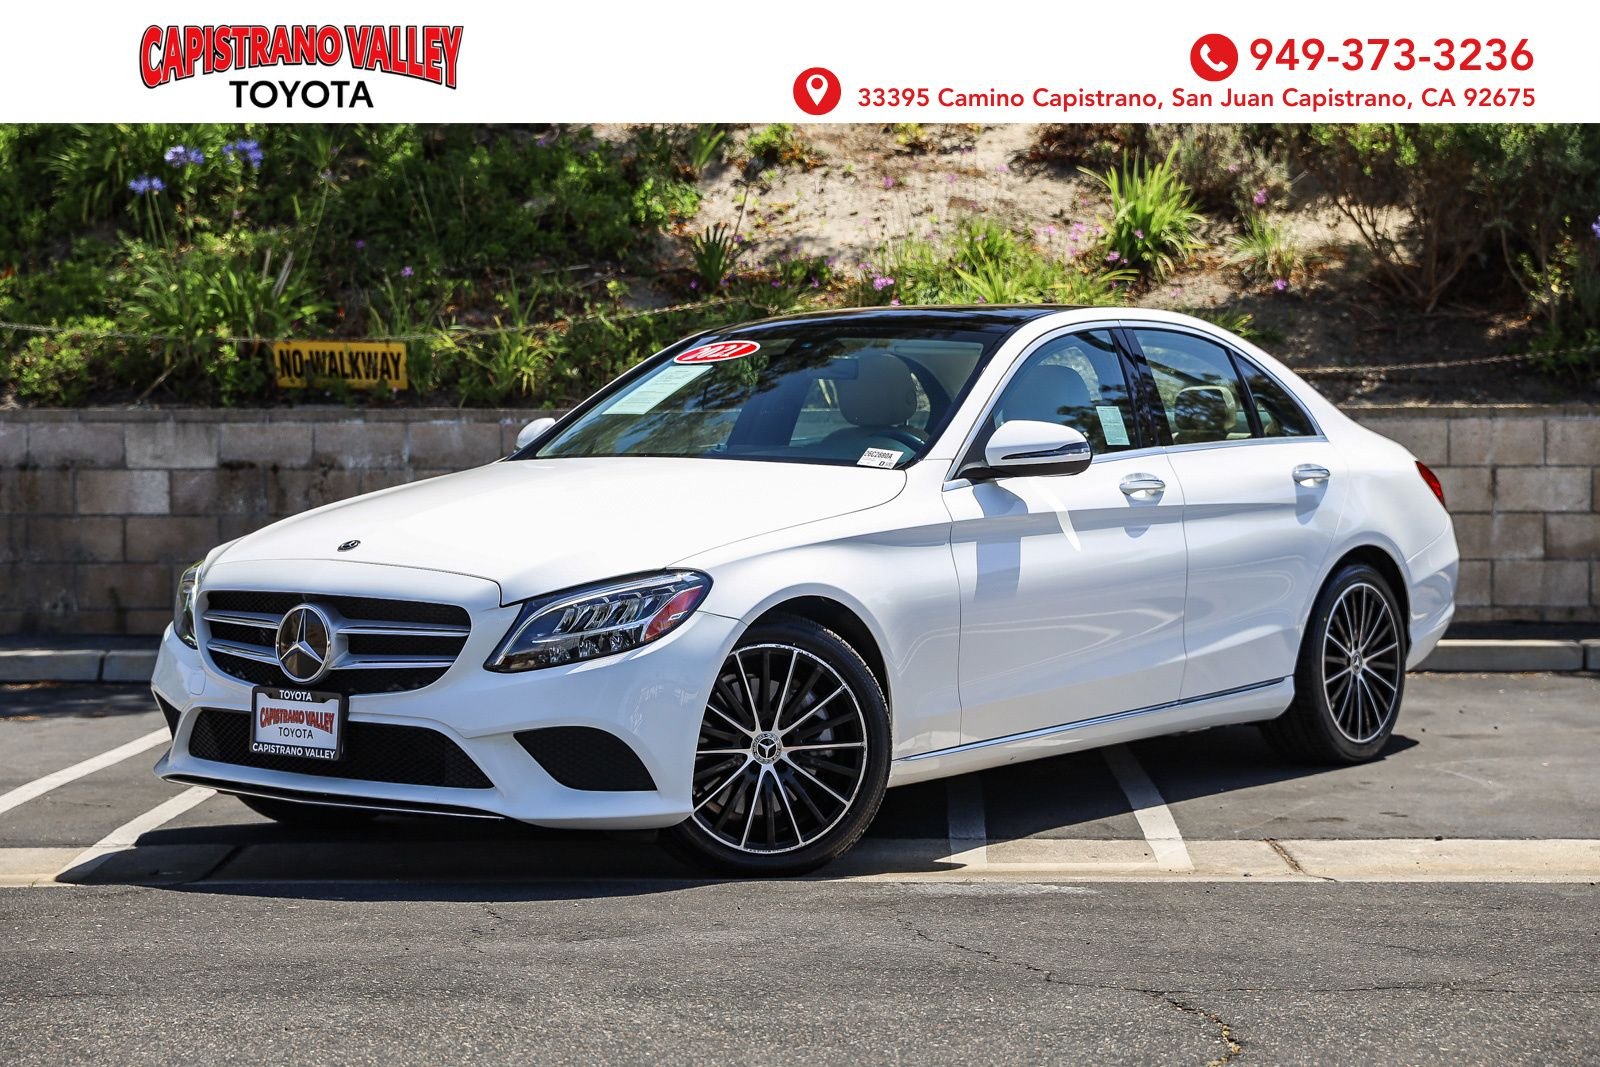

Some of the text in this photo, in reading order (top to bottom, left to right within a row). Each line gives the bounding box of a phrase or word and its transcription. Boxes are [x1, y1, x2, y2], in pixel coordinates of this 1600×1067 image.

[279, 349, 401, 380] NO WALKWAY
[279, 690, 313, 702] TOYOTA
[260, 707, 335, 735] CAPISTRANO VALLEY
[279, 727, 314, 740] TOYOTA
[252, 743, 336, 760] CAPISTRANO VALLEY
